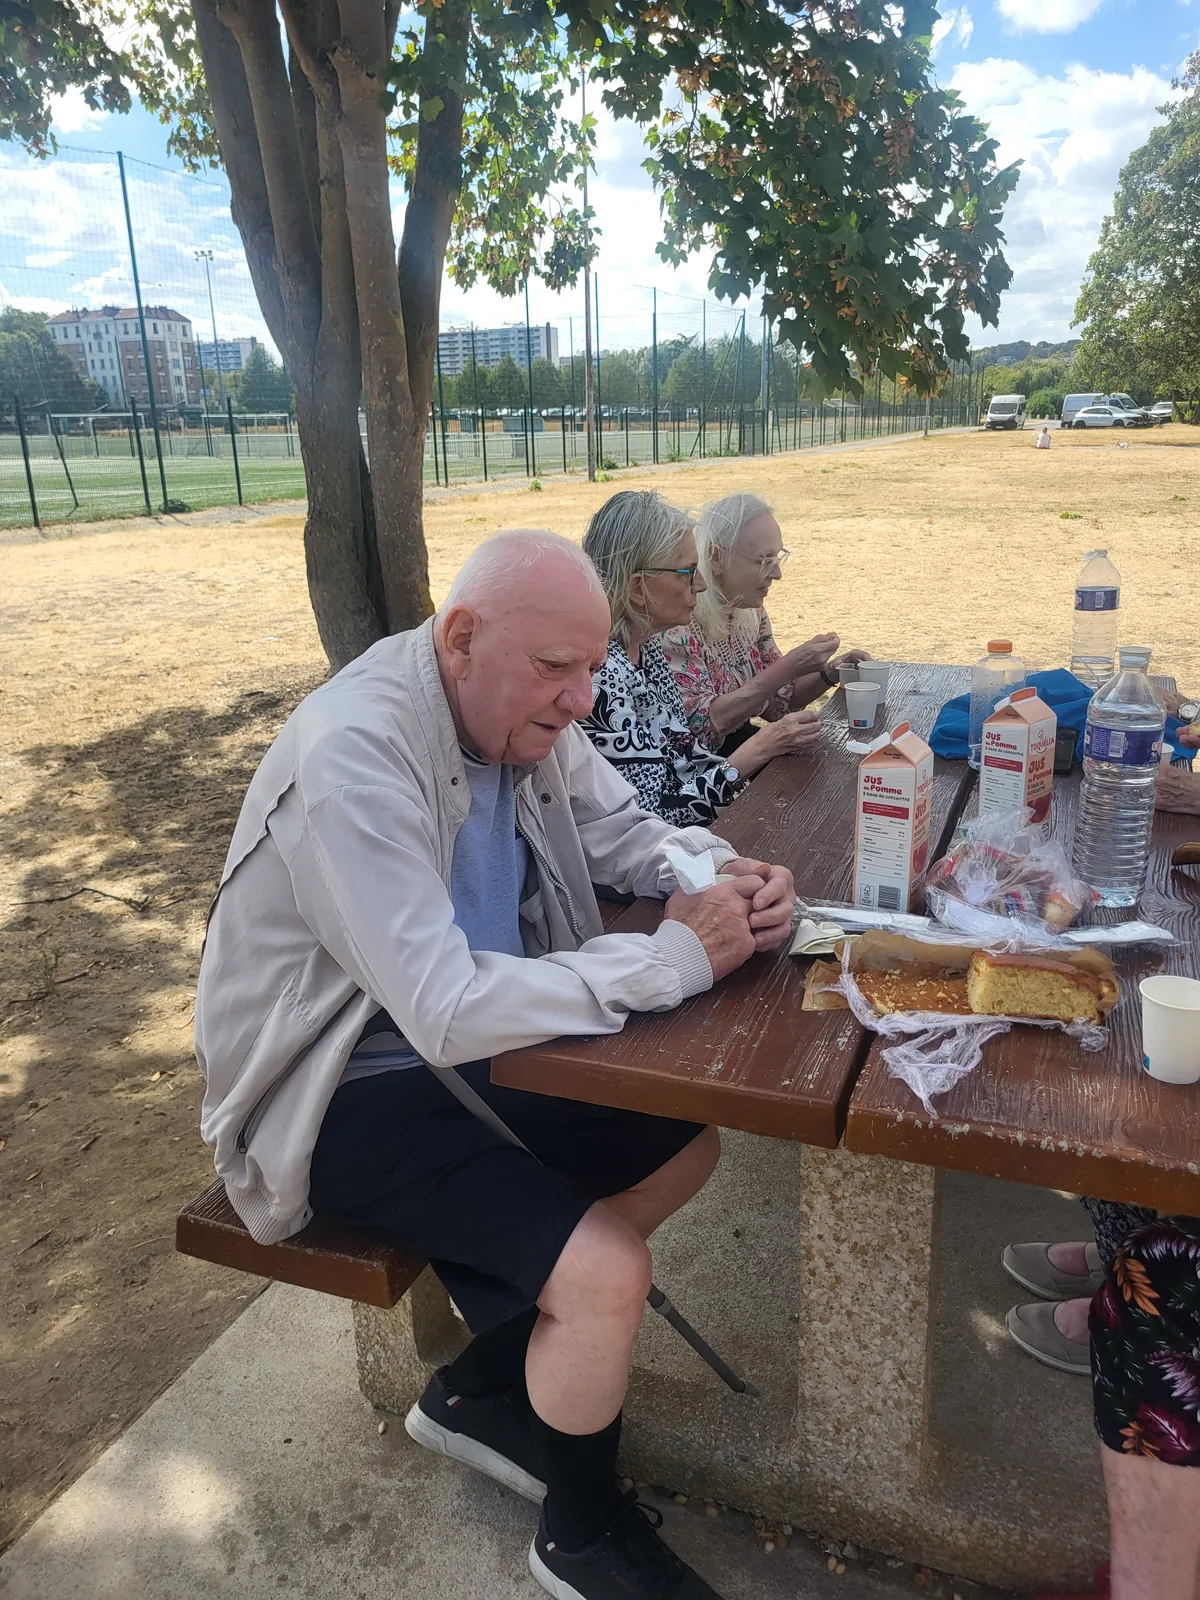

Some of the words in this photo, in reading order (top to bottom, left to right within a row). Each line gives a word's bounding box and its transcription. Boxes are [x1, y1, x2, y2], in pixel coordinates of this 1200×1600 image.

[986, 732, 1001, 741] JUS
[991, 740, 1017, 750] Pomme
[1028, 756, 1046, 774] JUS
[864, 775, 882, 785] JUS
[1032, 768, 1052, 782] Pomme
[870, 784, 903, 795] Pomme
[915, 799, 927, 820] JUS
